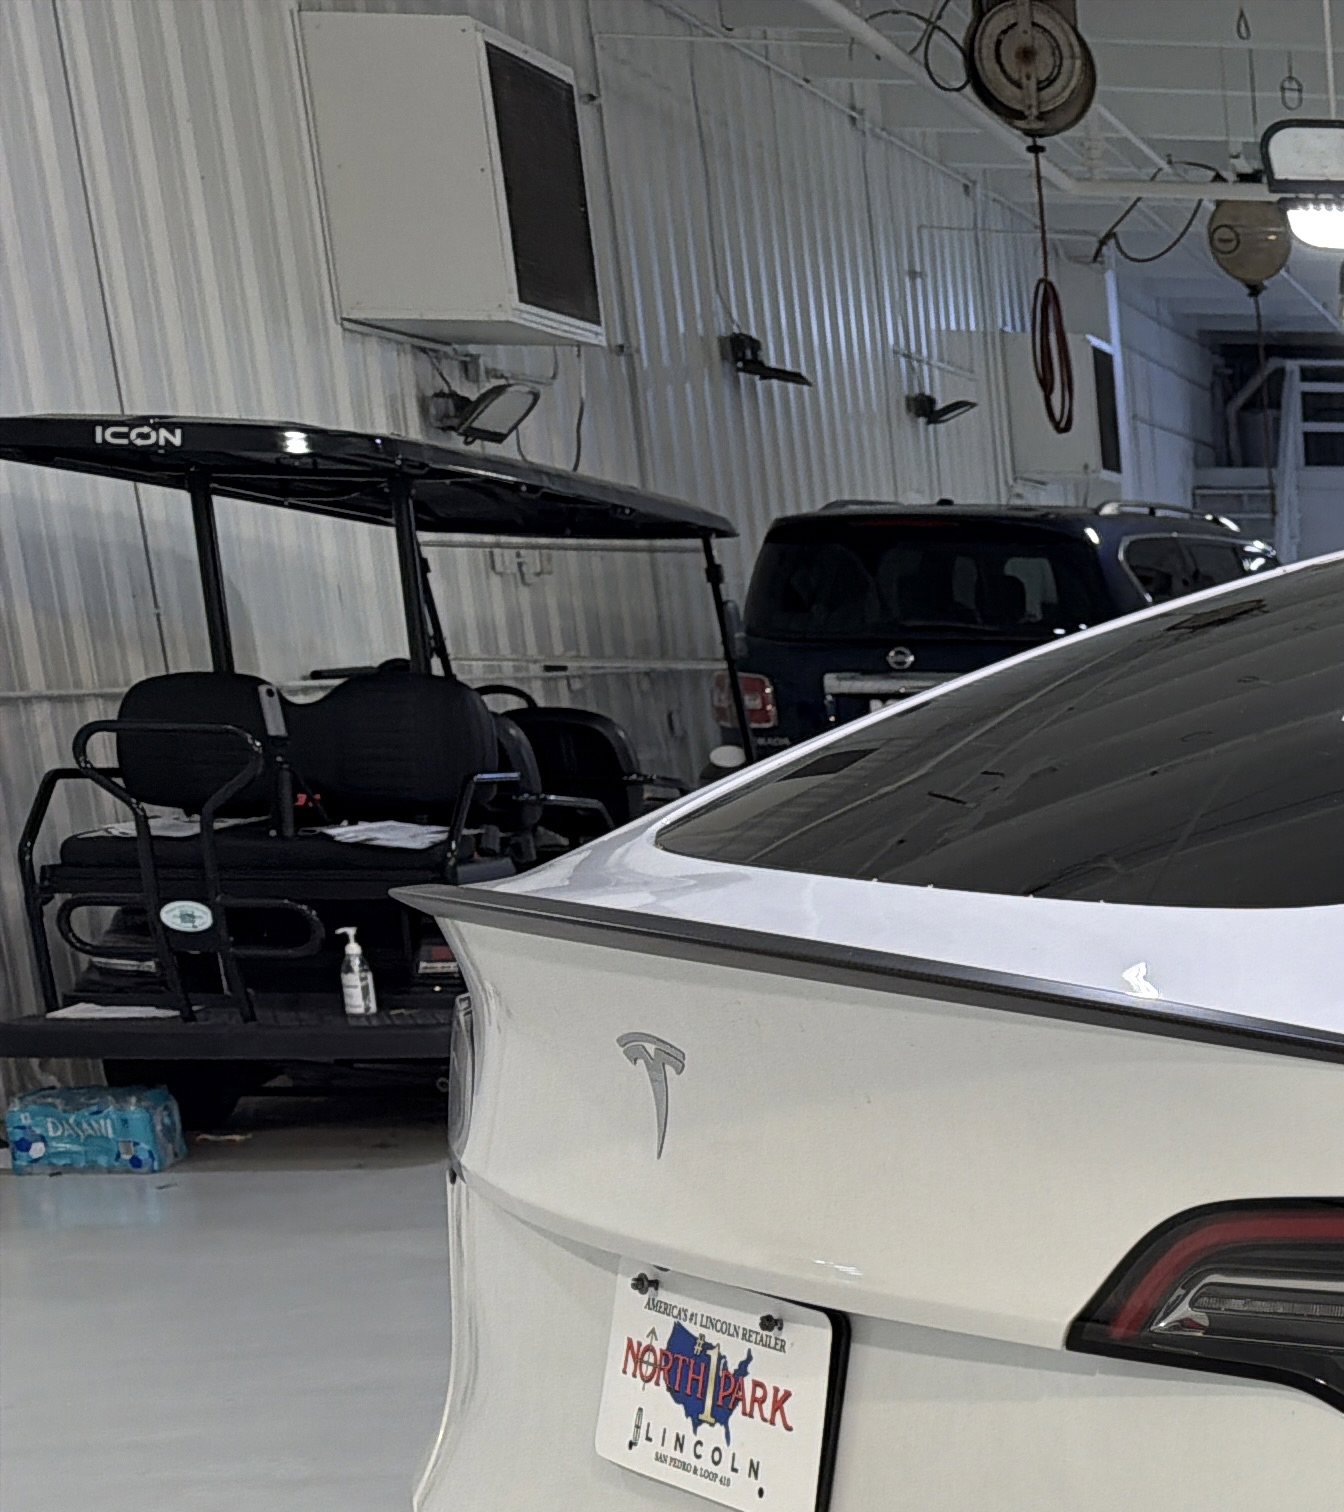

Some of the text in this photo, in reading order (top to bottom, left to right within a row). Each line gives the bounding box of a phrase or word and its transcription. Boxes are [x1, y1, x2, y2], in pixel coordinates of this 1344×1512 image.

[95, 425, 182, 447] ICON
[47, 1114, 113, 1142] DASANI
[644, 1298, 787, 1353] AMERICA'S #1 LINCOLN RETAILER
[622, 1336, 793, 1432] NORTH PARK
[645, 1422, 760, 1480] LINCOLN
[654, 1451, 669, 1465] SAN
[668, 1456, 692, 1474] PEDRO
[692, 1465, 699, 1476] &
[699, 1467, 719, 1483] LOOP
